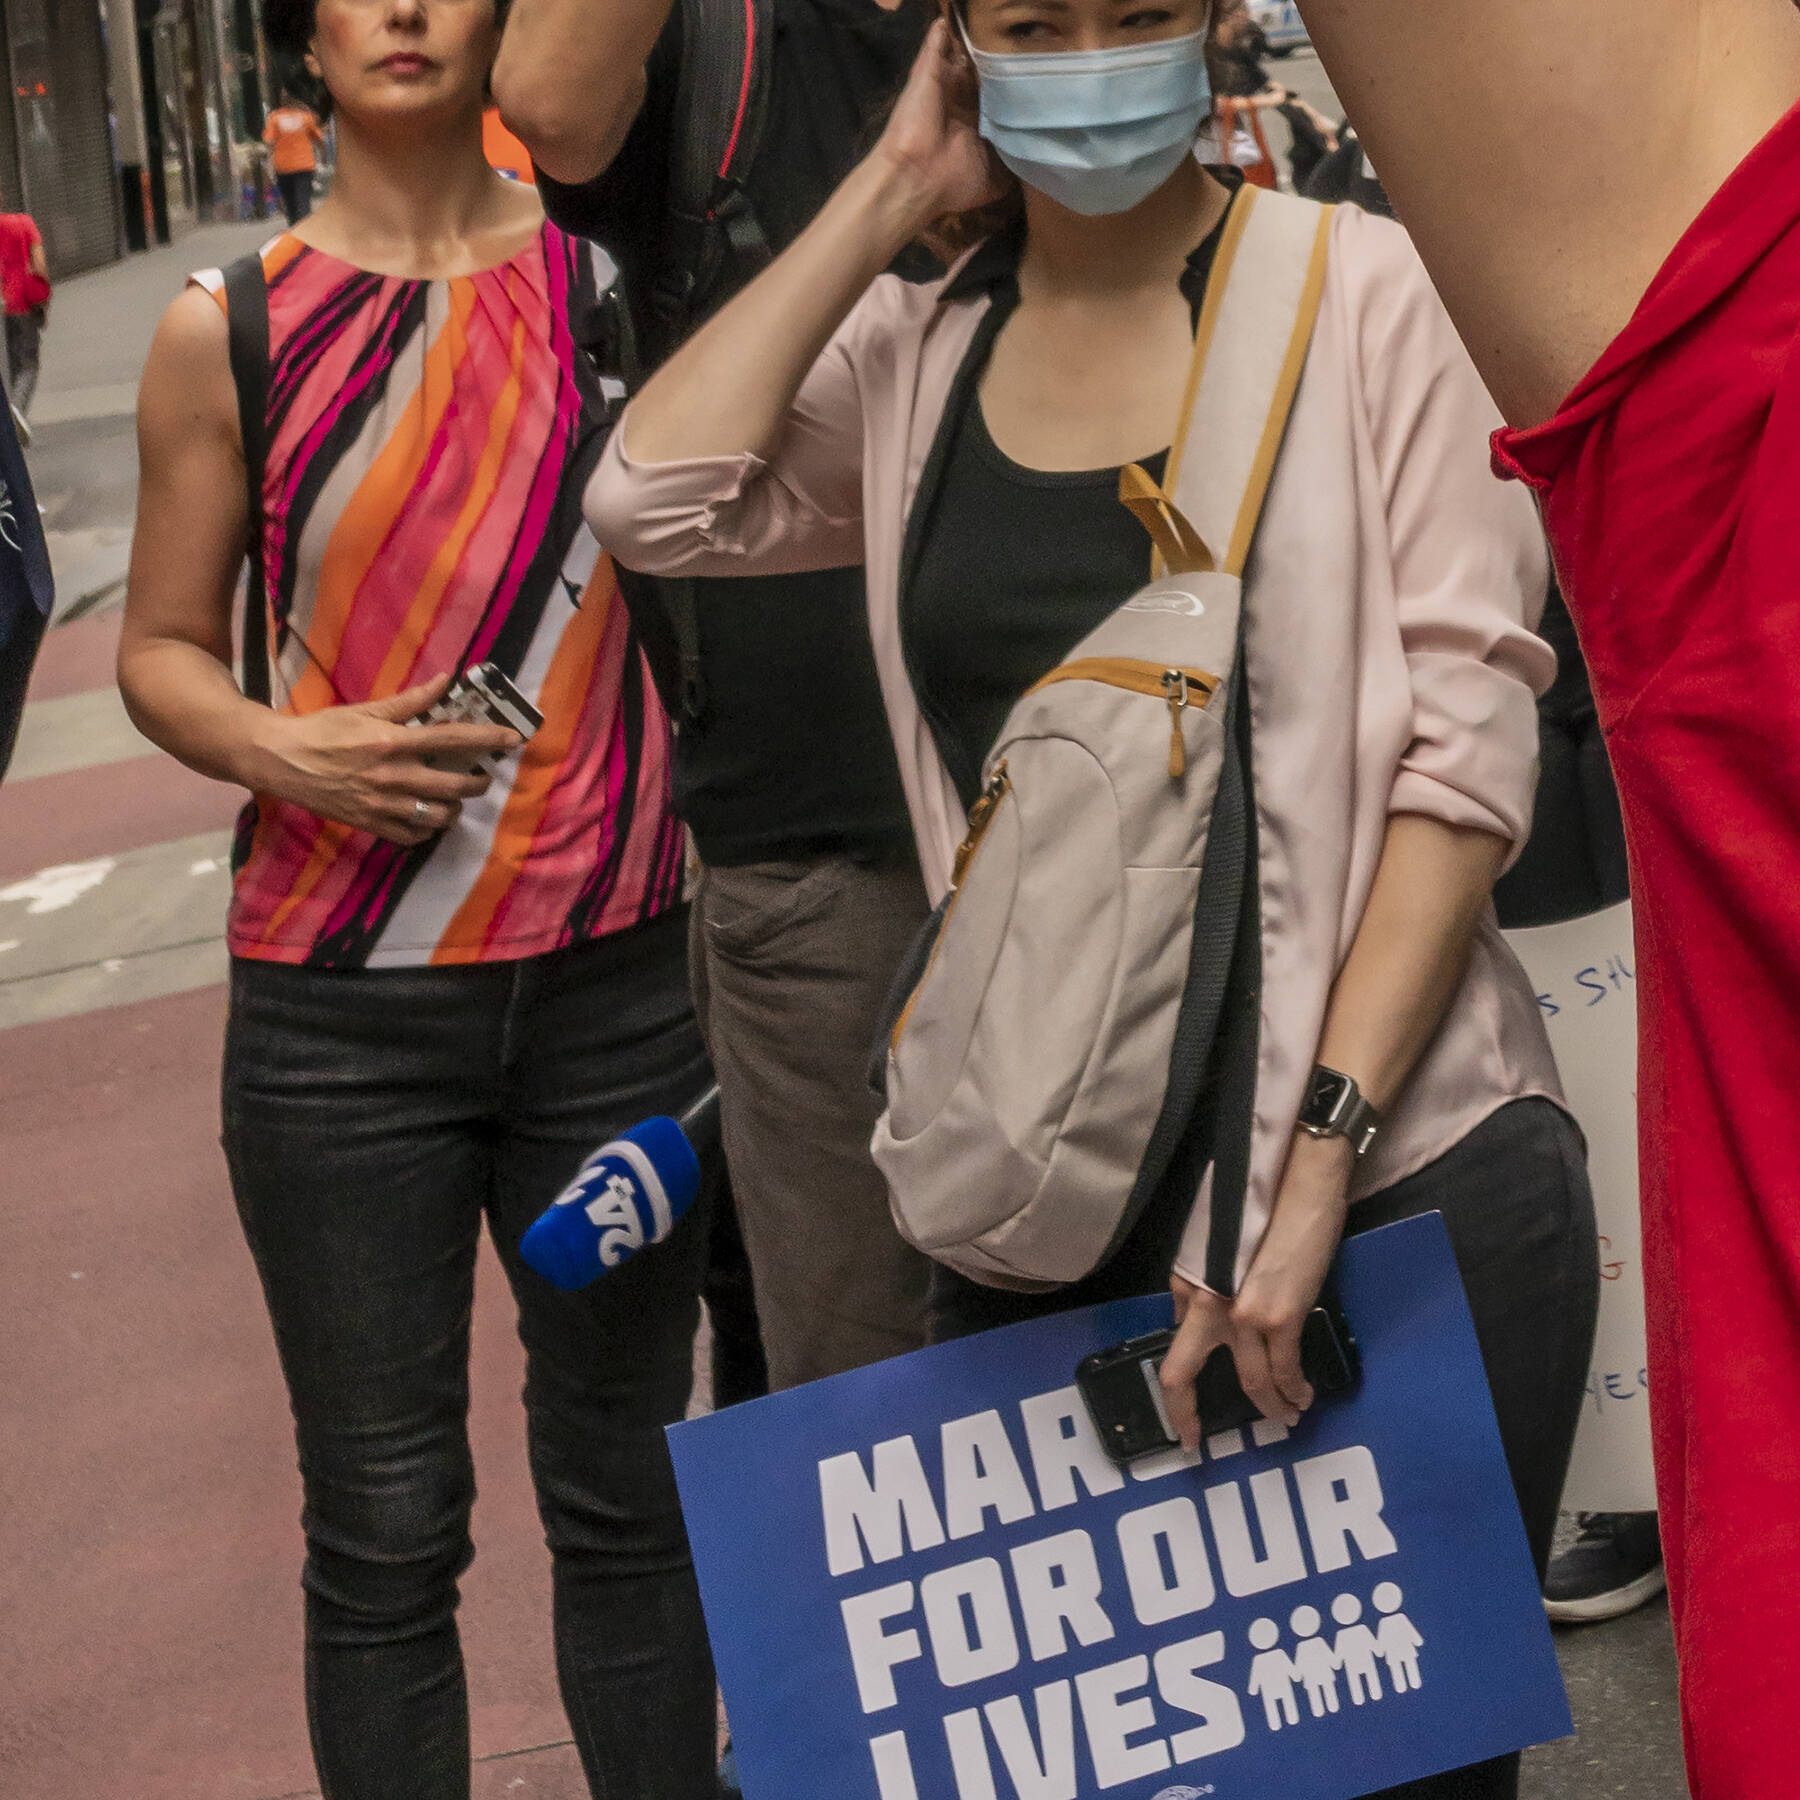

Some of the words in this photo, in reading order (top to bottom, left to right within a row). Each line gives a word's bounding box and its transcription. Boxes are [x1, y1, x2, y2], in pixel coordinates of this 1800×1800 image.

[817, 1384, 1293, 1578] MAR
[839, 1526, 1104, 1715] FOR
[1117, 1443, 1400, 1627] OUR
